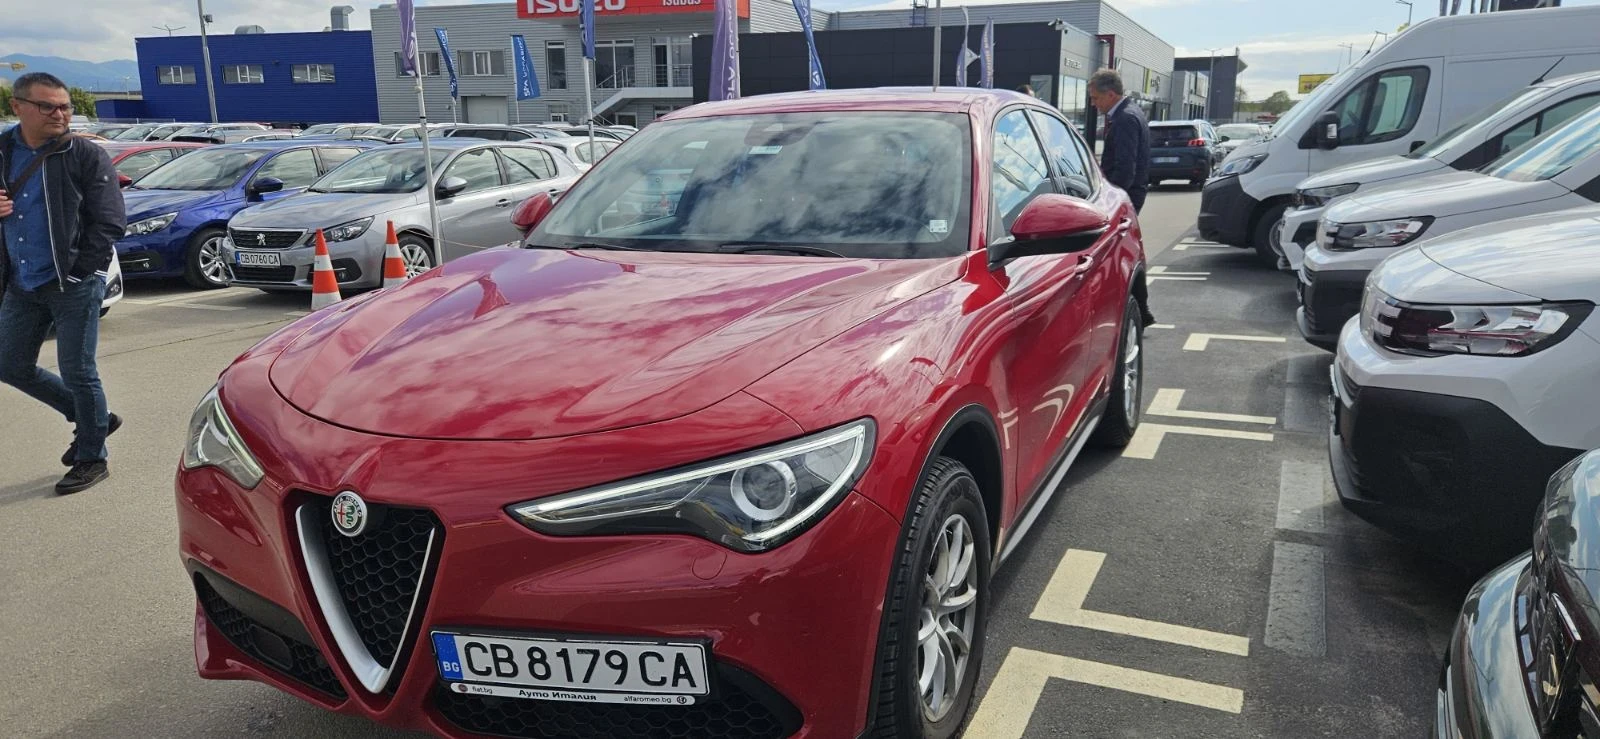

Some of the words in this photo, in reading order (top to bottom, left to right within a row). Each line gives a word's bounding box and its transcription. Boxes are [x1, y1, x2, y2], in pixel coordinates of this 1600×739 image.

[240, 254, 250, 264] CB
[250, 254, 267, 264] 0760
[268, 255, 279, 264] CA
[442, 661, 460, 672] BG
[463, 641, 519, 679] CB
[528, 646, 629, 685] 8179
[639, 651, 697, 688] CA
[472, 685, 493, 694] fiat.bg
[624, 694, 672, 705] alfaromeo.bg
